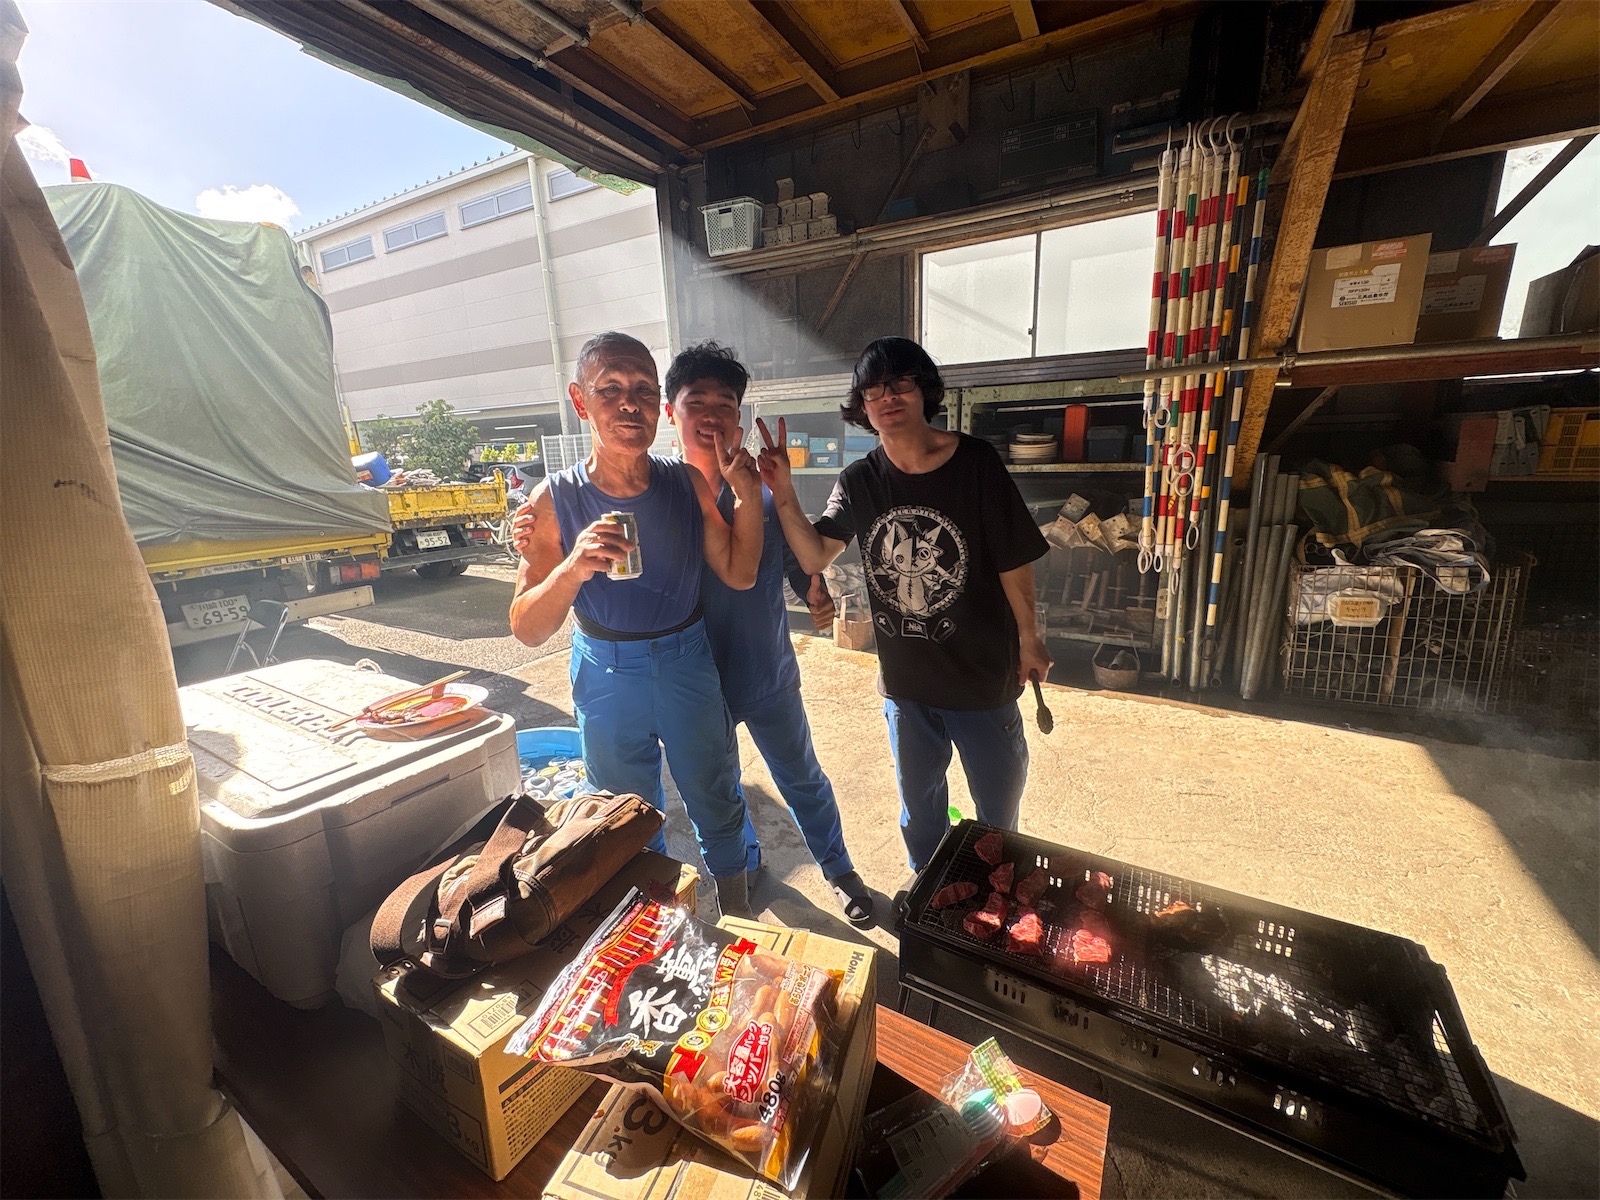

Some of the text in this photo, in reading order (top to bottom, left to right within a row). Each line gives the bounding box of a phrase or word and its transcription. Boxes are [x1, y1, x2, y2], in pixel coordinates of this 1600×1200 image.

[202, 604, 249, 626] 69-59
[723, 1020, 758, 1097] 大容量パック
[737, 1024, 773, 1103] ジッパー付き
[759, 1071, 787, 1123] 480g
